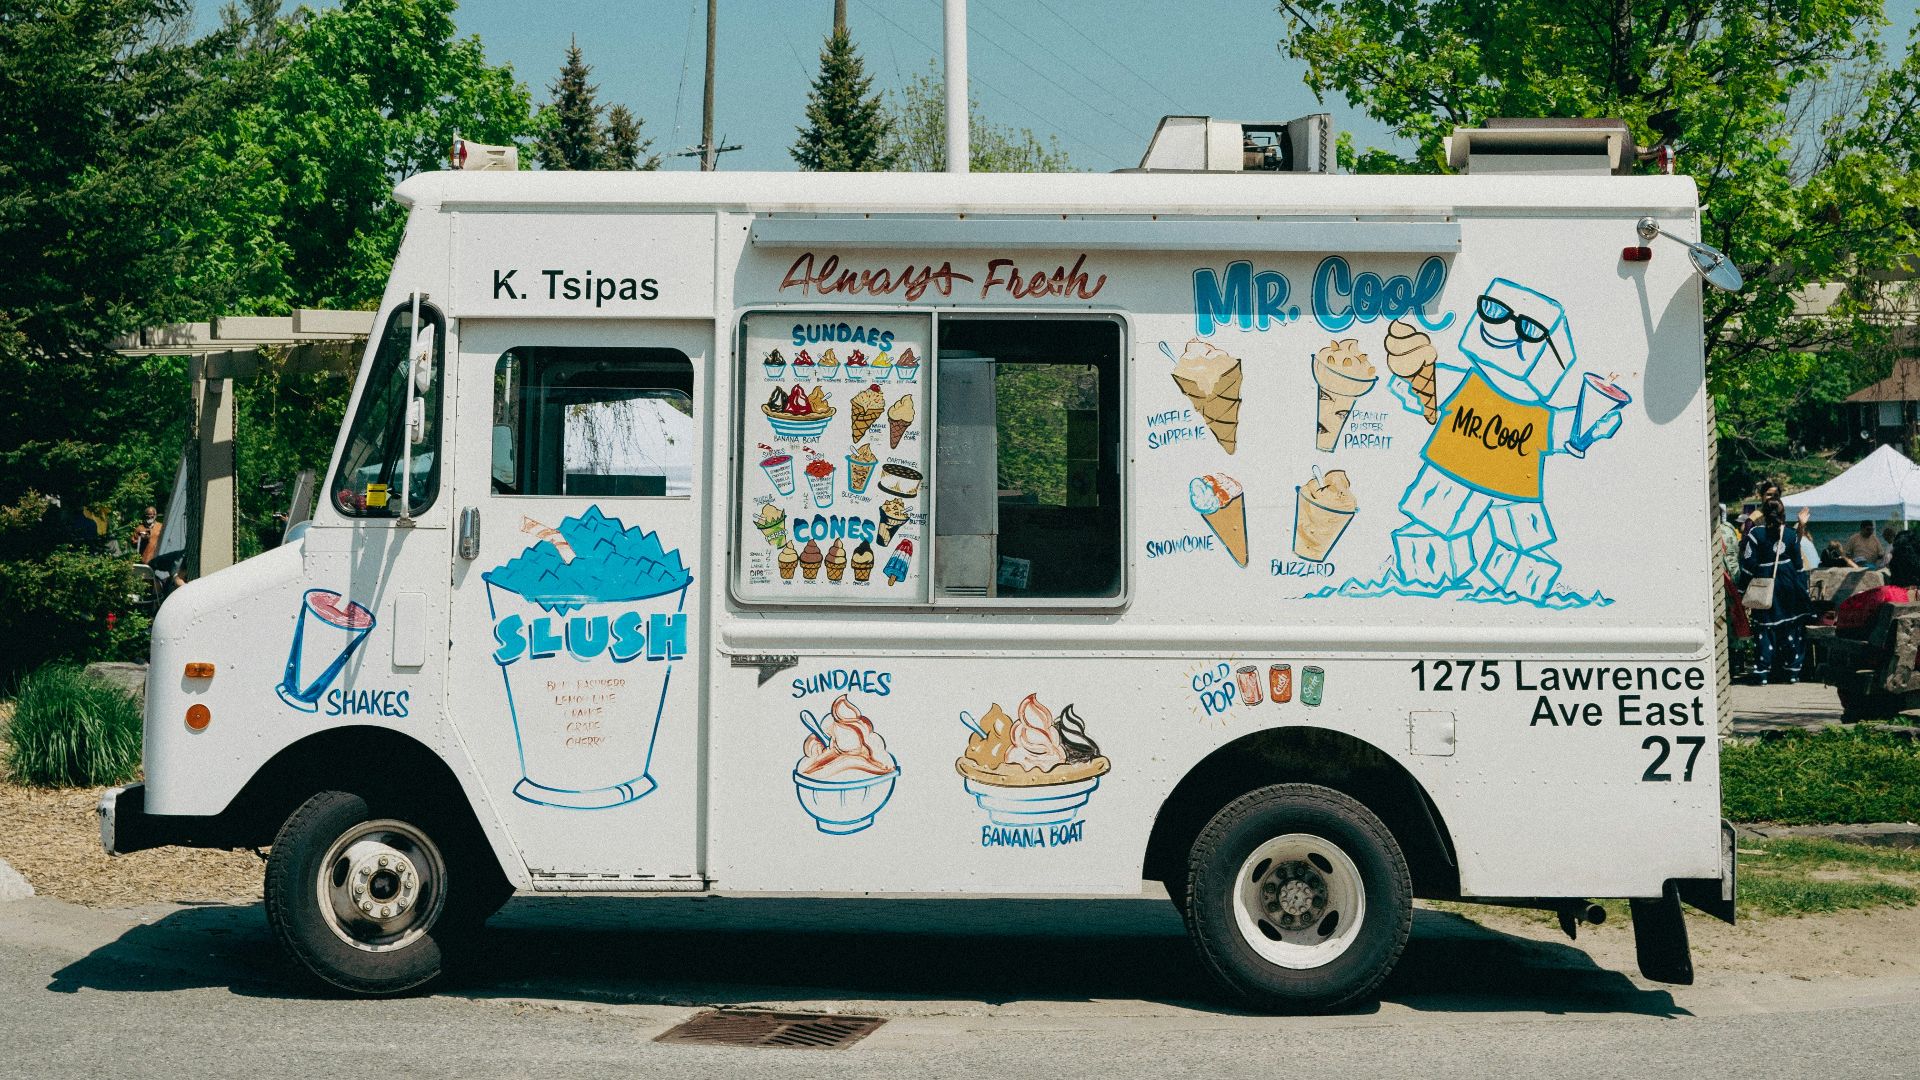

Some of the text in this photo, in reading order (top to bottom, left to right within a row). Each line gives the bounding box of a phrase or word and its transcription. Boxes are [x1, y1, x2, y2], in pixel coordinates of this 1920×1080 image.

[493, 269, 659, 308] K. Tsipas
[778, 251, 1108, 302] Always Fresh
[791, 322, 895, 352] SUNDAES
[1146, 409, 1192, 428] WAFFLE
[773, 435, 821, 444] BANANA BOAT
[1147, 426, 1206, 450] SUPREME
[1344, 433, 1394, 449] PARFAIT
[793, 513, 876, 544] CONES
[1145, 535, 1214, 559] SNOWCONE
[749, 569, 764, 577] DIPS
[1271, 559, 1336, 578] BLIZZARD
[492, 611, 688, 667] SLUSH
[791, 669, 892, 699] SUNDAES
[1192, 663, 1230, 692] COLD
[1411, 660, 1705, 692] 1275 Lawrence
[325, 688, 410, 718] SHAKES
[1200, 681, 1236, 716] POP
[1529, 694, 1704, 727] Ave East
[1640, 735, 1706, 782] 27
[981, 819, 1086, 848] BANANA BOAT
